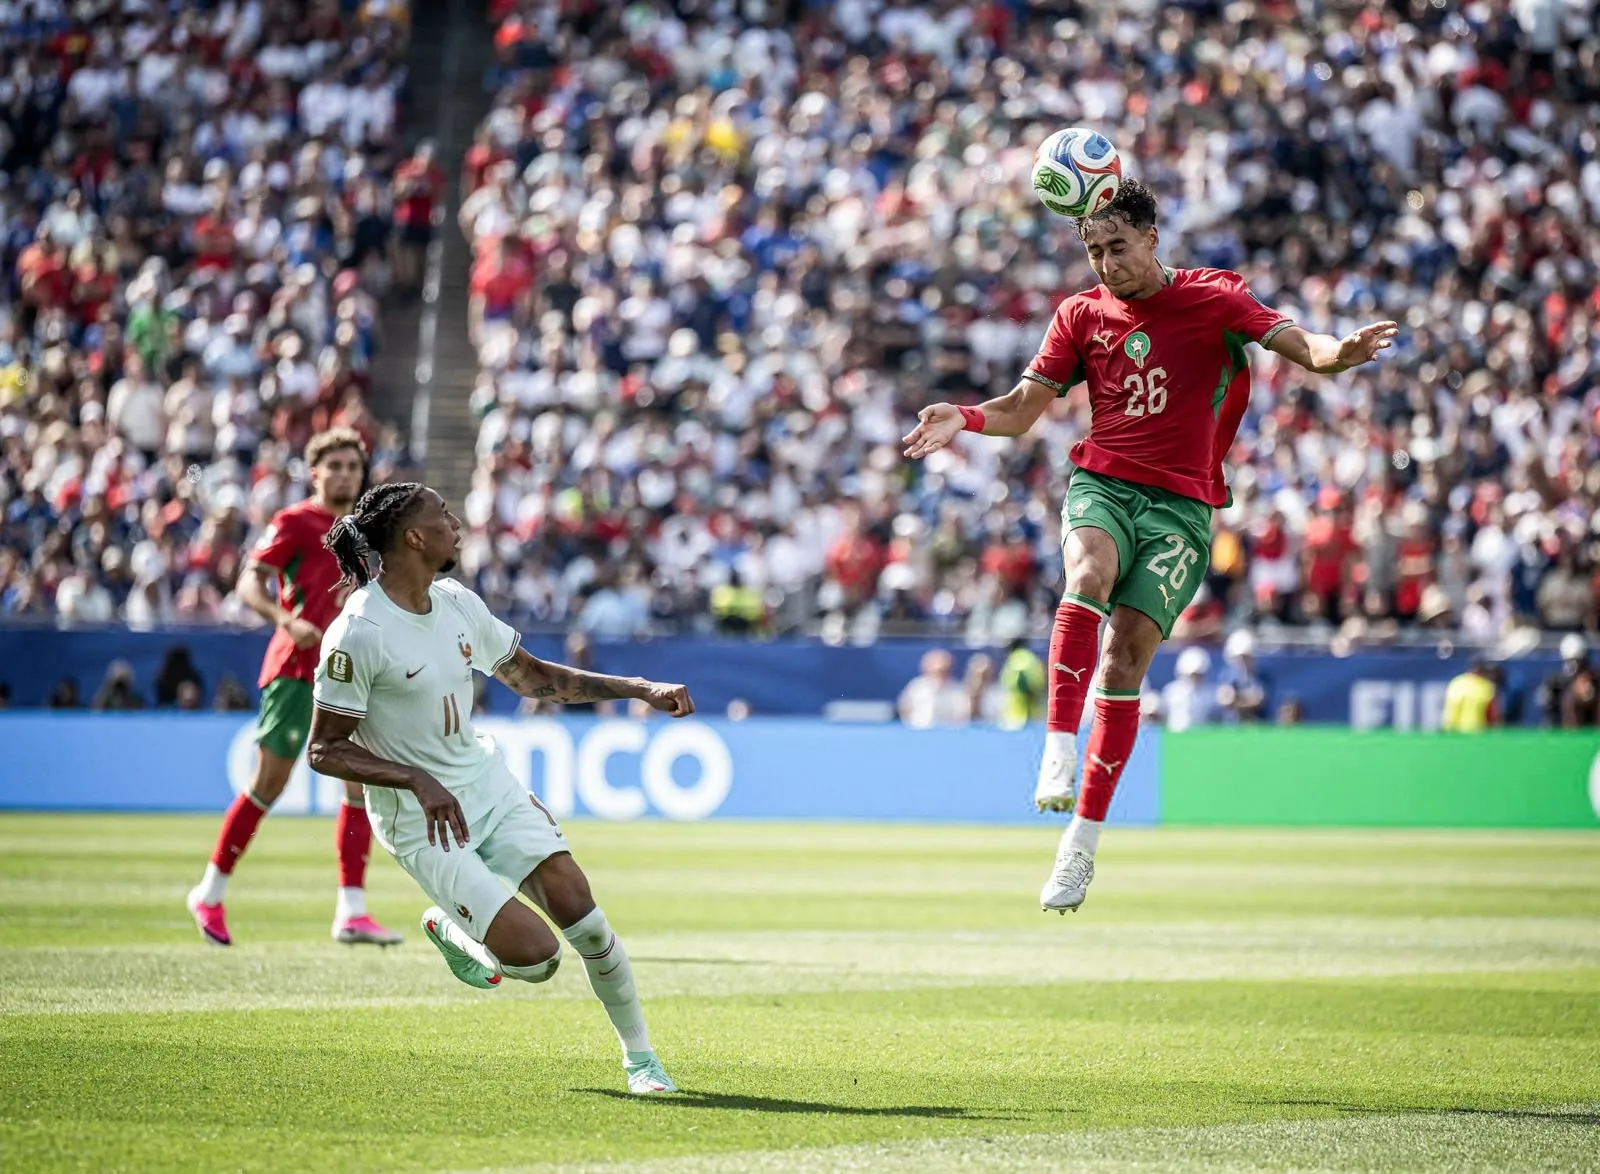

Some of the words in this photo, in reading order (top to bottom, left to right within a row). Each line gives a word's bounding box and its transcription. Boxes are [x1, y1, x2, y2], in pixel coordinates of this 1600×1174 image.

[1124, 367, 1168, 416] 26
[1146, 535, 1199, 590] 26
[443, 693, 460, 737] 11
